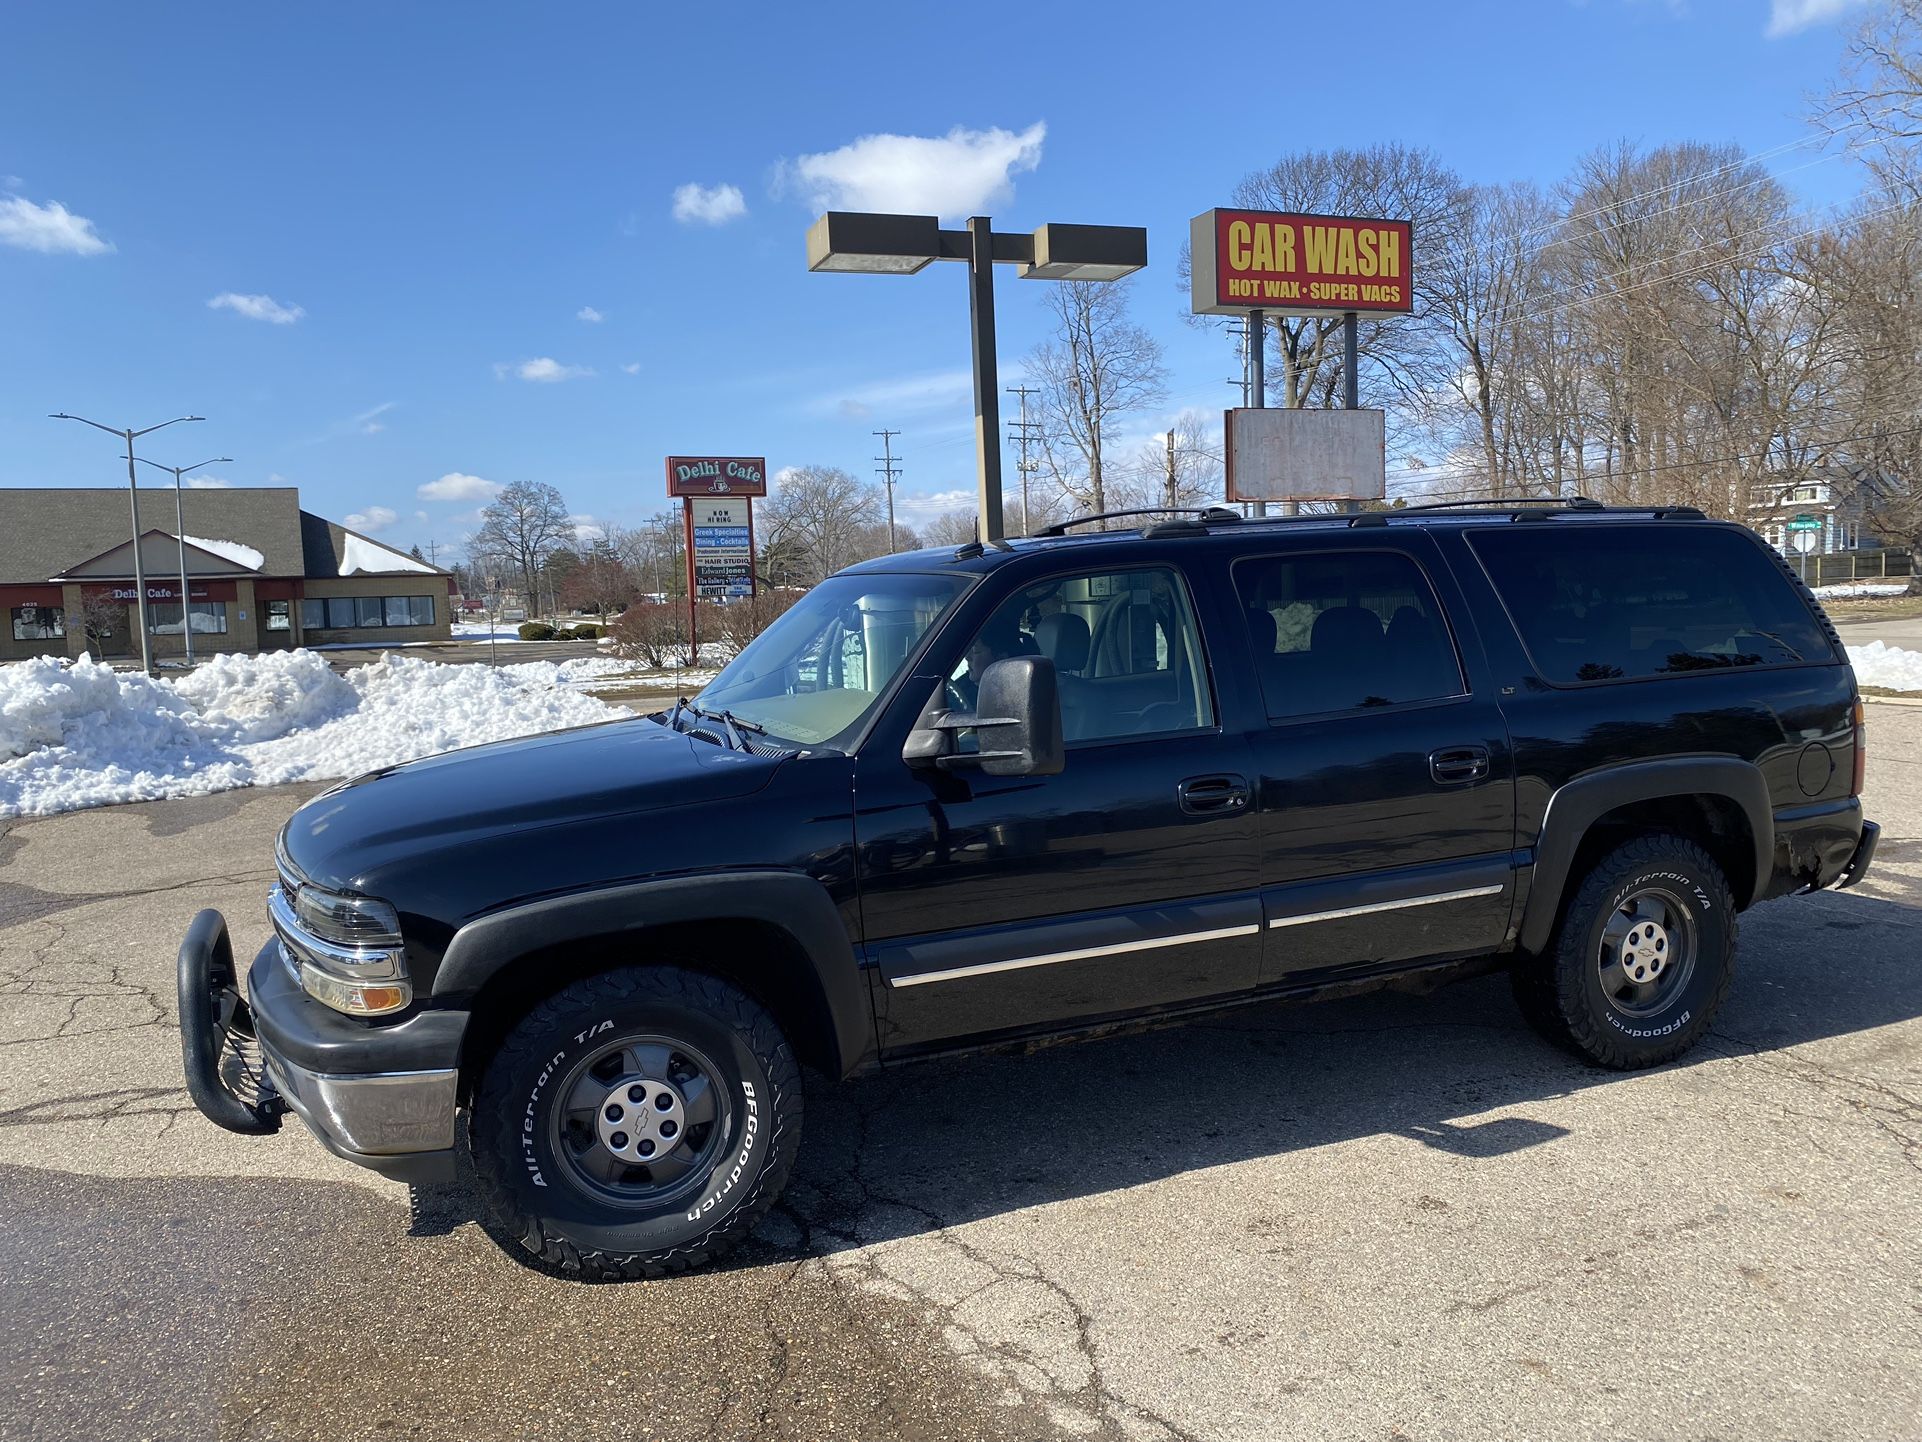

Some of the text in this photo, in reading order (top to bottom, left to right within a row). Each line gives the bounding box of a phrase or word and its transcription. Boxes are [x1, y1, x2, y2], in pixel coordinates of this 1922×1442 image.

[1228, 220, 1399, 278] CAR WASH
[1228, 278, 1401, 303] HOT WAX SUPER VACS
[677, 461, 760, 482] Delhi Cafe
[695, 528, 713, 536] Greek
[695, 537, 749, 547] Dining Cocktails
[726, 566, 746, 575] Jones
[114, 589, 139, 599] Delh
[147, 588, 172, 598] Cafe
[701, 586, 727, 595] HEWITT
[1693, 885, 1712, 910] T/A
[1605, 1010, 1692, 1038] BFGoodrich
[521, 1019, 615, 1188] All-Terrain T/A
[687, 1080, 758, 1223] BFGoodrich
